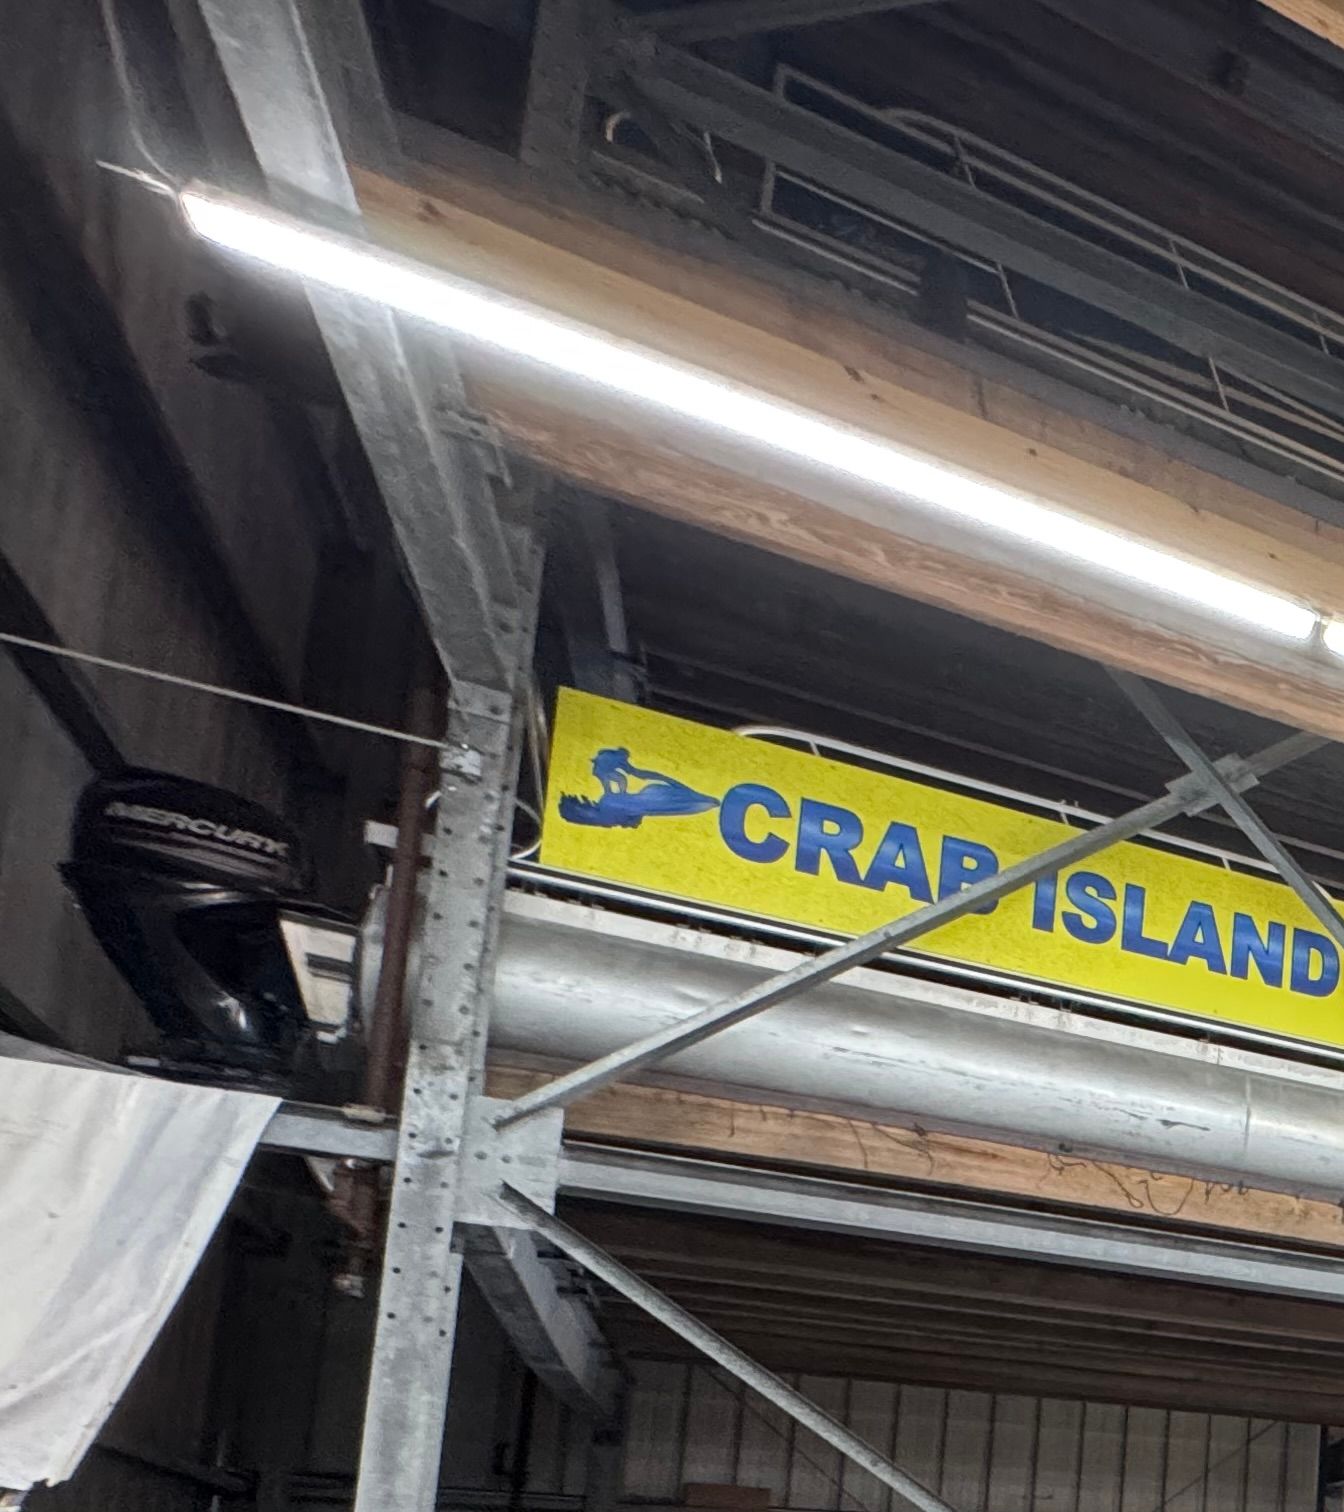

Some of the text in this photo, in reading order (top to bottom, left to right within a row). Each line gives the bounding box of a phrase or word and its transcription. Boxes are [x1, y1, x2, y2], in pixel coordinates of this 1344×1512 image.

[105, 800, 290, 857] MERCURY
[719, 782, 1000, 915] CRAB
[1031, 868, 1341, 999] ISLAND
